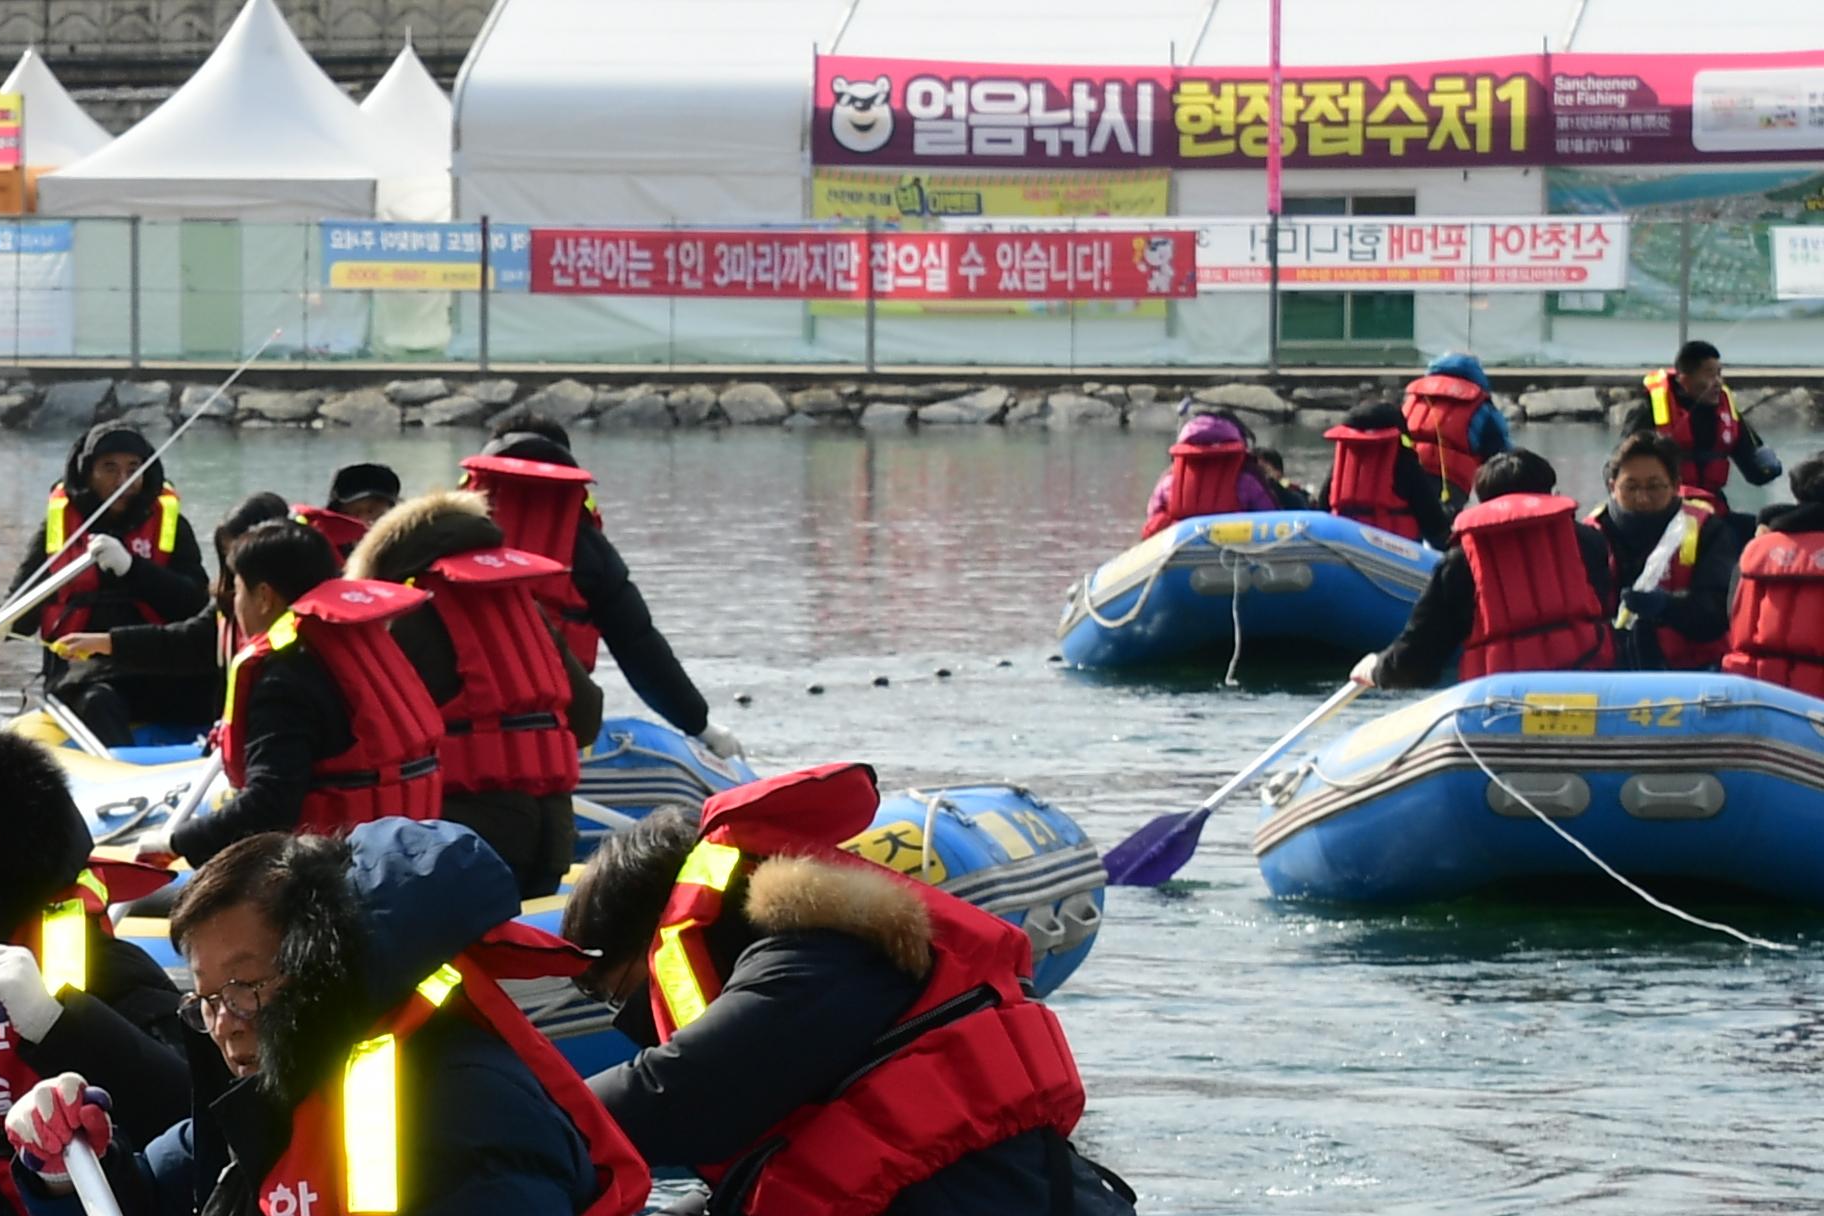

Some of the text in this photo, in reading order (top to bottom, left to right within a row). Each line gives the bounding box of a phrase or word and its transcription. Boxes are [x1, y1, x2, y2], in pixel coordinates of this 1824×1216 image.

[904, 75, 1528, 159] 얼음낚시 현장접수처1
[1554, 91, 1628, 109] Ice Fishing
[549, 240, 1112, 292] 산천어는 1인 3마리까지만 잡으실 수 있습니다!
[1628, 698, 1684, 727] 42
[1012, 810, 1057, 846] 21
